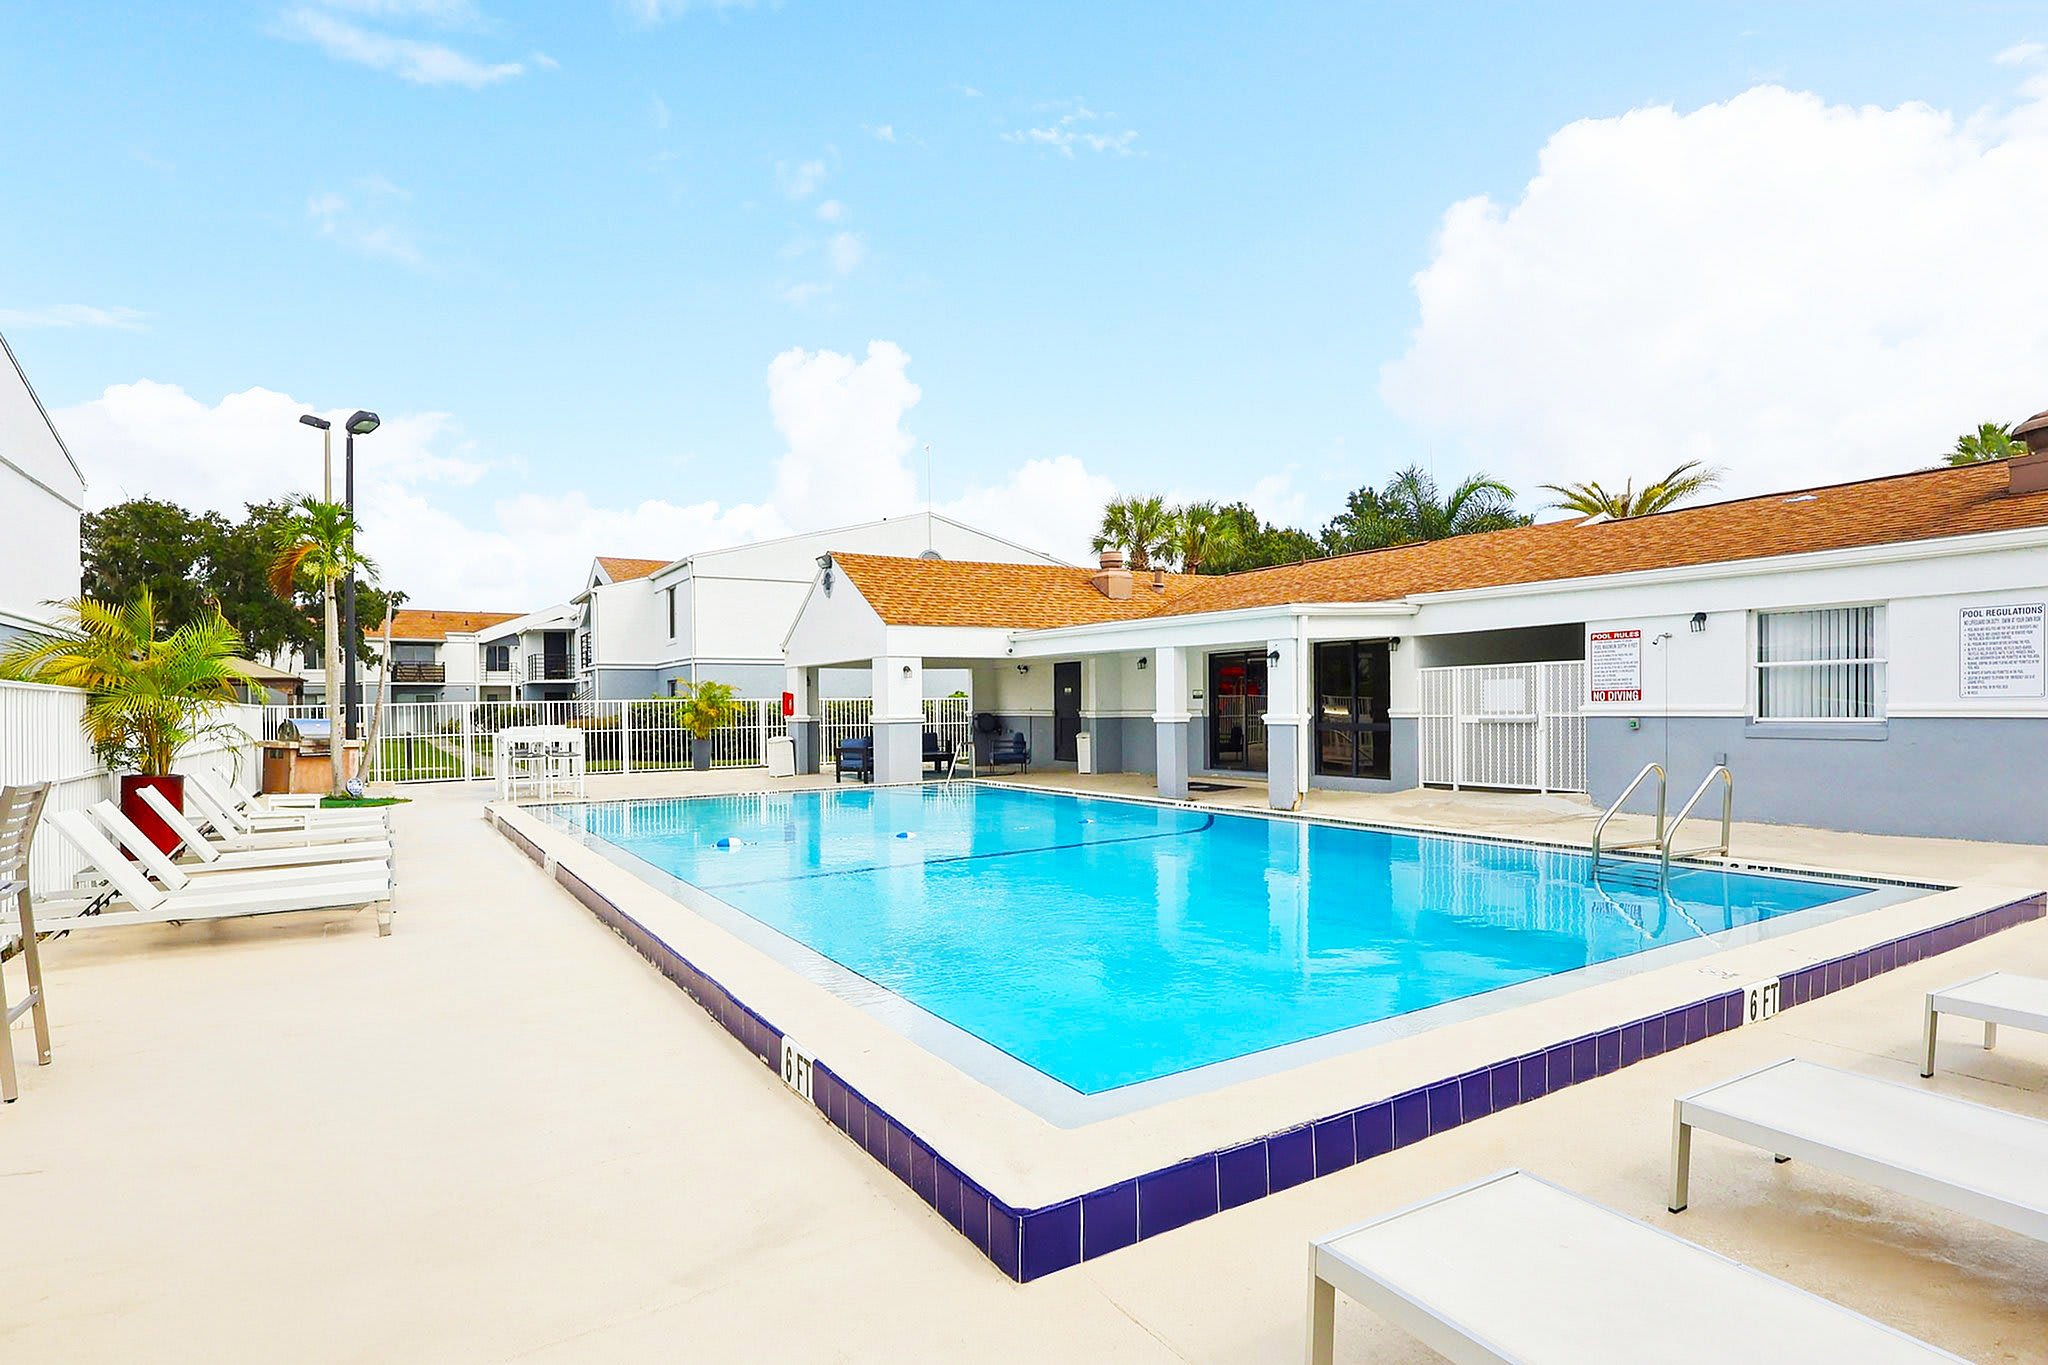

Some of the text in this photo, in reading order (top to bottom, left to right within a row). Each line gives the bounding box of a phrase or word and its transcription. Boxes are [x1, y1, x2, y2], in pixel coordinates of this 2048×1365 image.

[1962, 606, 2043, 618] POOL REGULATIONS
[1593, 690, 1639, 701] NO DIVING
[1750, 982, 1778, 1021] 6 FT
[786, 1046, 811, 1098] 6 FT
